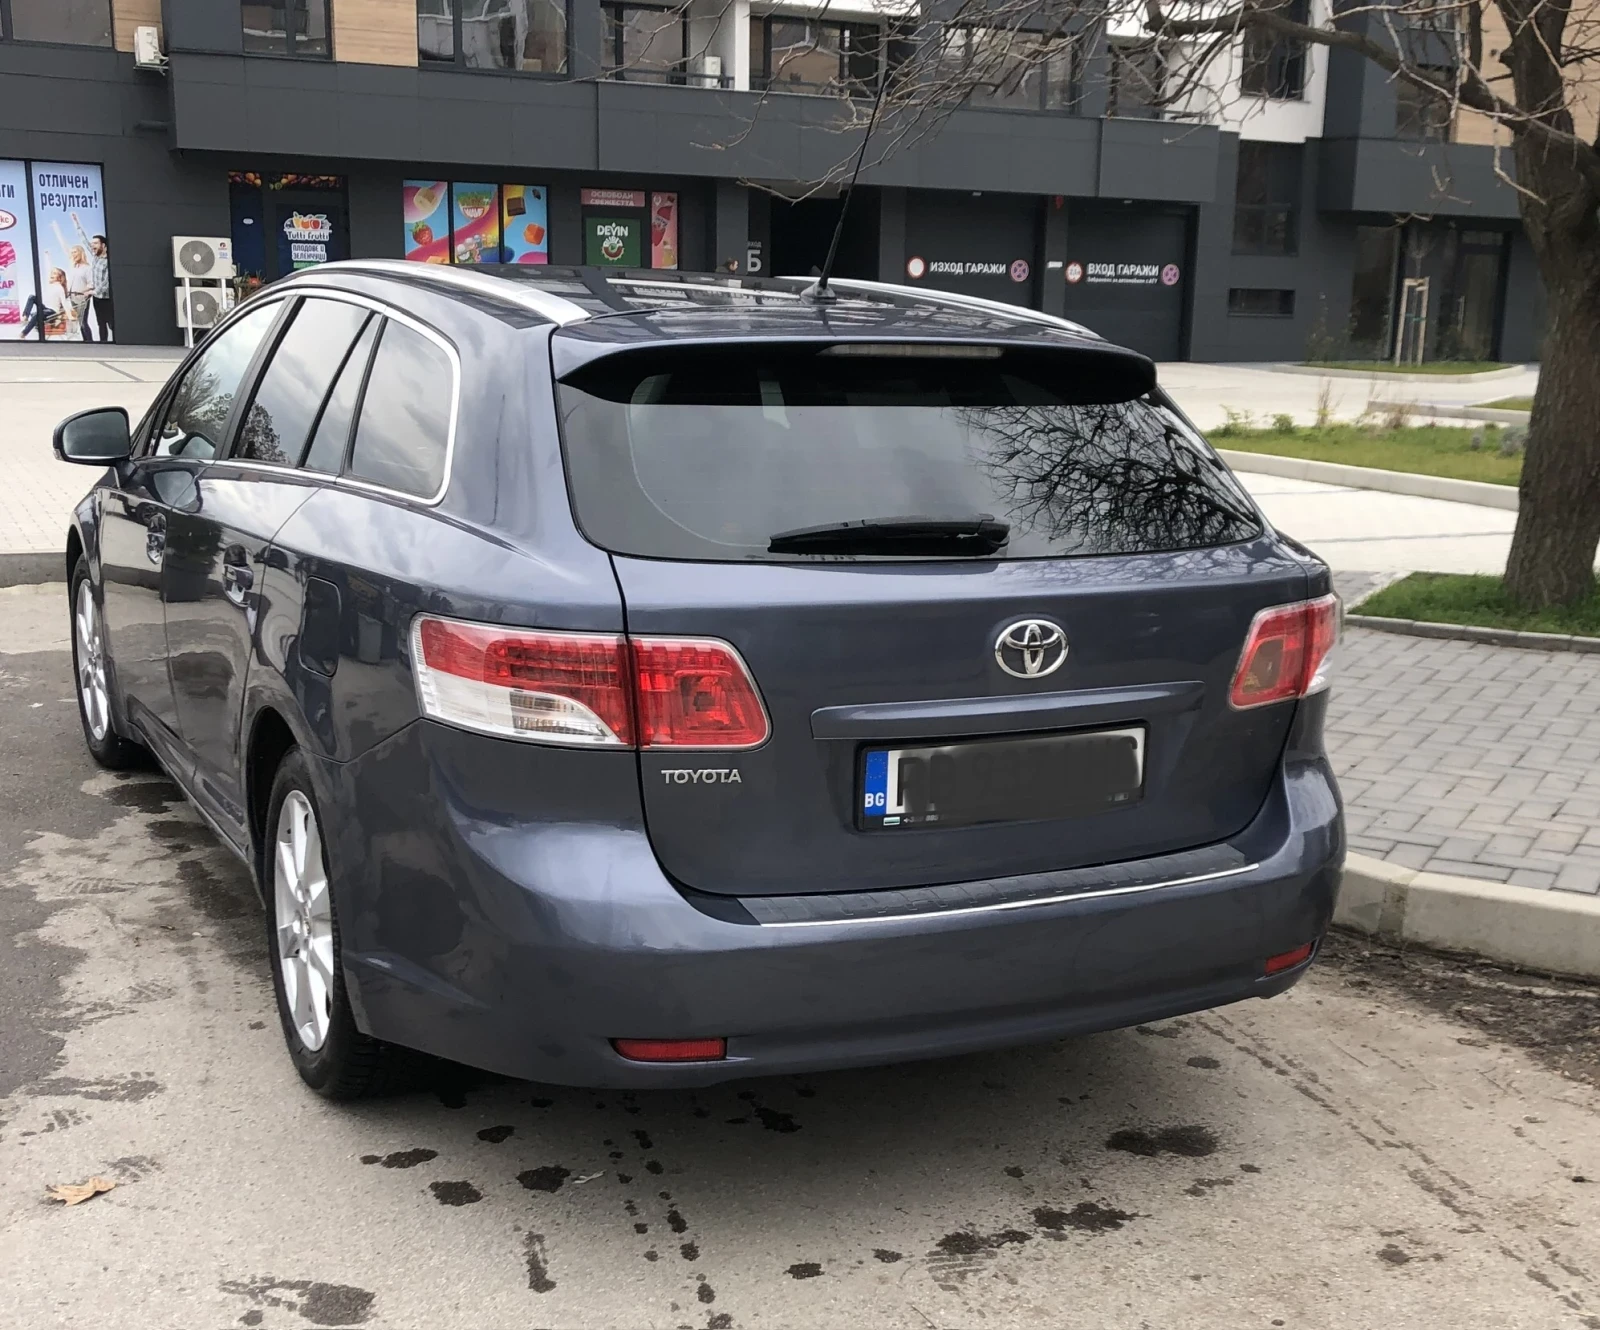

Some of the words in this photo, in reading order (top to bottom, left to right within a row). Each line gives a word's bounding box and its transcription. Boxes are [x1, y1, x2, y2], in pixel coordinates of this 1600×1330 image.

[39, 173, 89, 189] отличен
[40, 190, 98, 212] резултат!
[288, 231, 306, 240] Tutti
[596, 222, 629, 237] DEVIN
[747, 249, 762, 272] Б
[930, 261, 964, 275] ИЗХОД
[965, 262, 1007, 274] ГАРАЖИ
[1087, 263, 1115, 276] ВХОД
[1117, 264, 1159, 276] ГАРАЖИ
[661, 769, 742, 784] TOYOTA
[865, 792, 885, 808] BG
